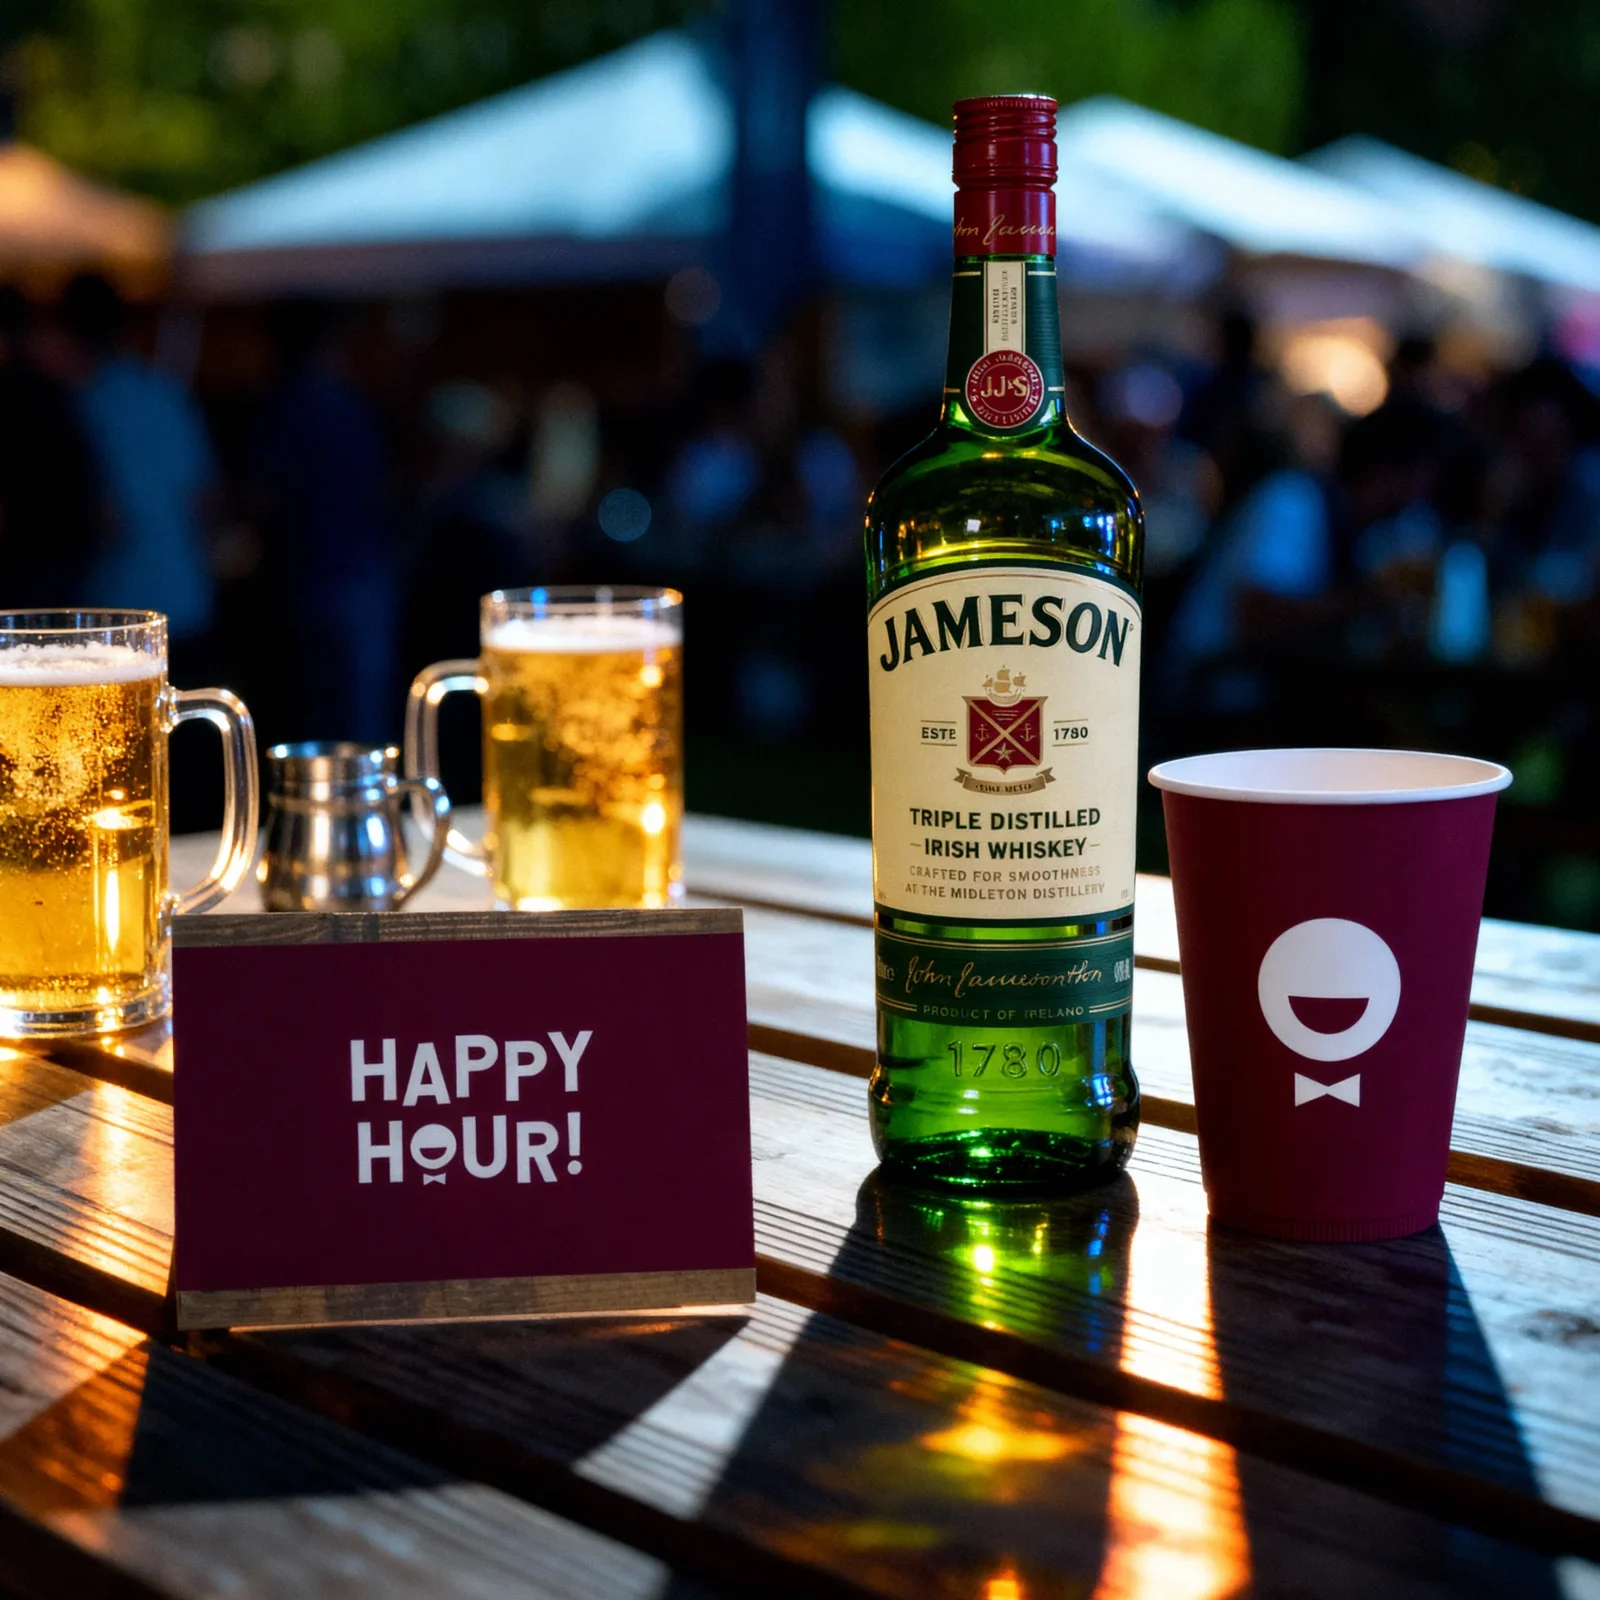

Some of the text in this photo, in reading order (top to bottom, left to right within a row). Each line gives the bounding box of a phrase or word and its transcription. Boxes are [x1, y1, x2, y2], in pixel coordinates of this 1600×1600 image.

[880, 594, 1130, 672] JAMESON
[1053, 726, 1089, 741] 1780
[909, 807, 1101, 831] TRIPLE DISTILLED
[924, 836, 1088, 860] IRISH WHISKEY
[909, 865, 1101, 883] CRAFTED FOR SMOOTHNESS
[905, 883, 918, 894] AT
[920, 884, 947, 898] THE
[950, 888, 1027, 901] MIDLETON
[904, 955, 952, 994] John
[923, 1004, 991, 1021] PRODUCT
[997, 1009, 1018, 1021] OF
[350, 1029, 594, 1107] HAPPY
[947, 1039, 1062, 1079] 1780
[357, 1111, 583, 1186] HOUR!
